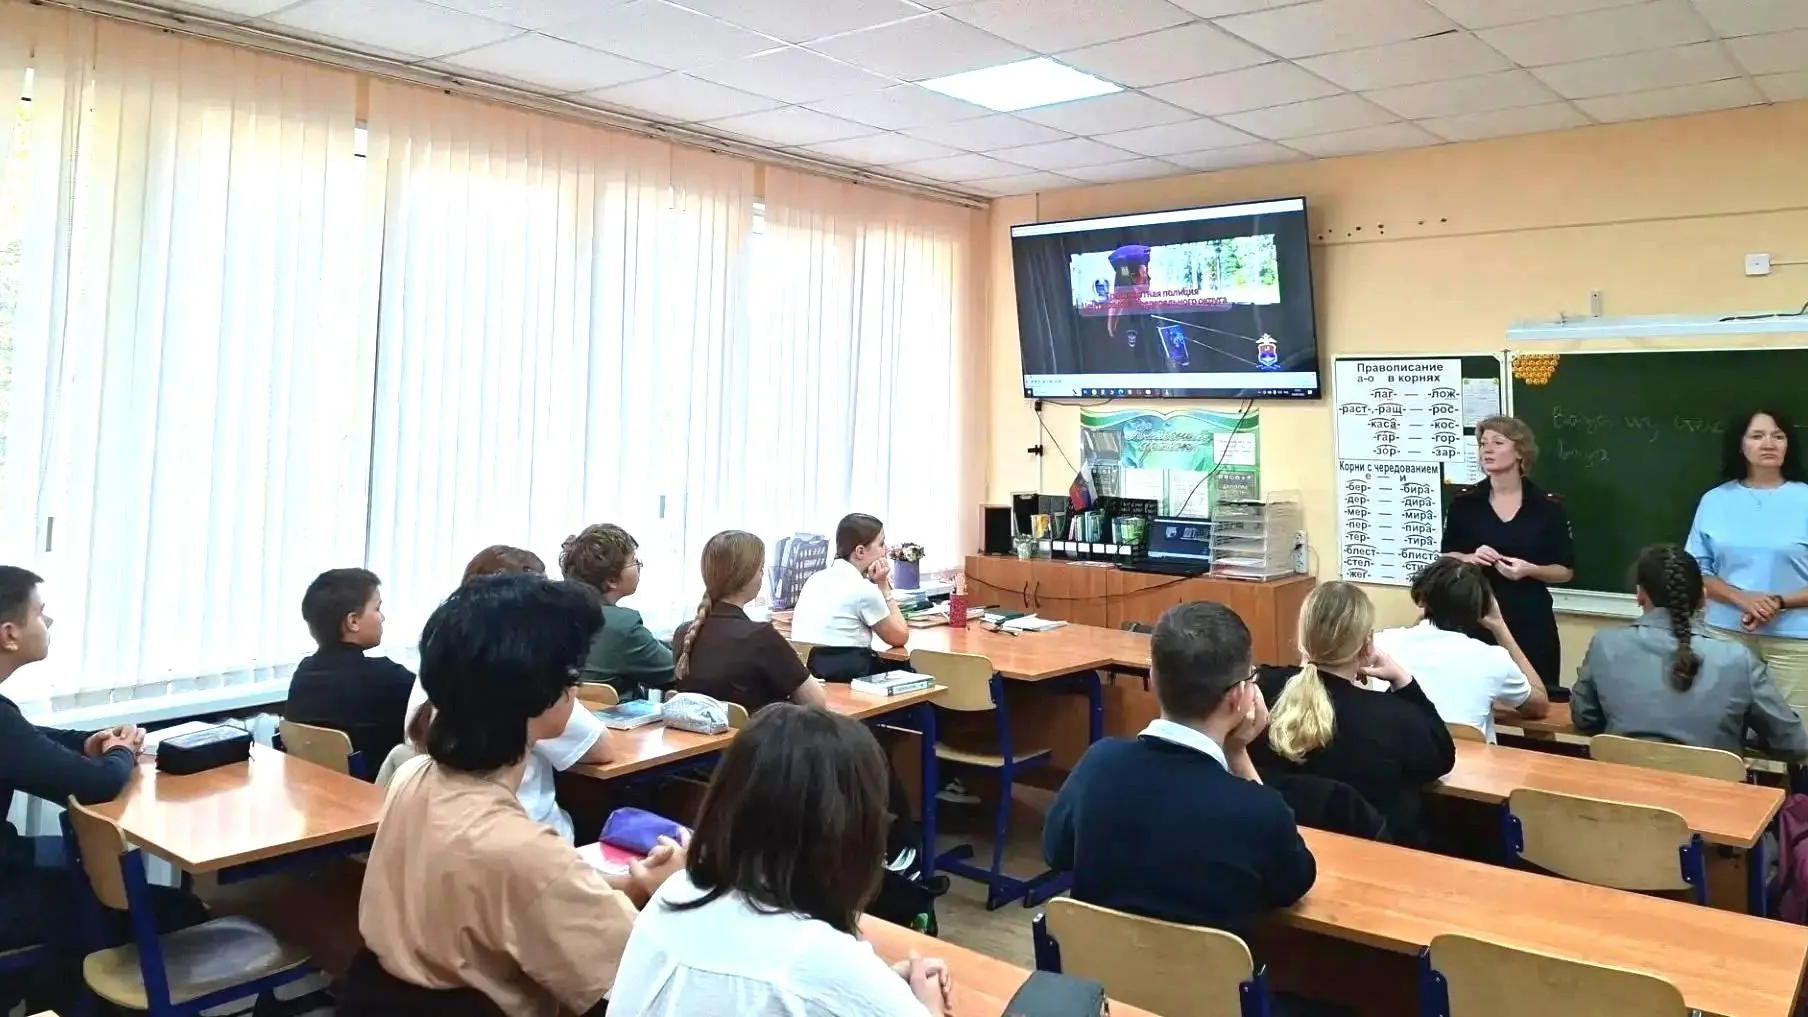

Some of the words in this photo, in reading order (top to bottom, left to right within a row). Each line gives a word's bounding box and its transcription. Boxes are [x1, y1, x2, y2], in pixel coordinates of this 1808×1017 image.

[1357, 363, 1444, 374] Правописание
[1398, 374, 1441, 384] корнях
[1339, 461, 1365, 474] Корни
[1367, 464, 1372, 472] с
[1374, 463, 1439, 475] чередованием
